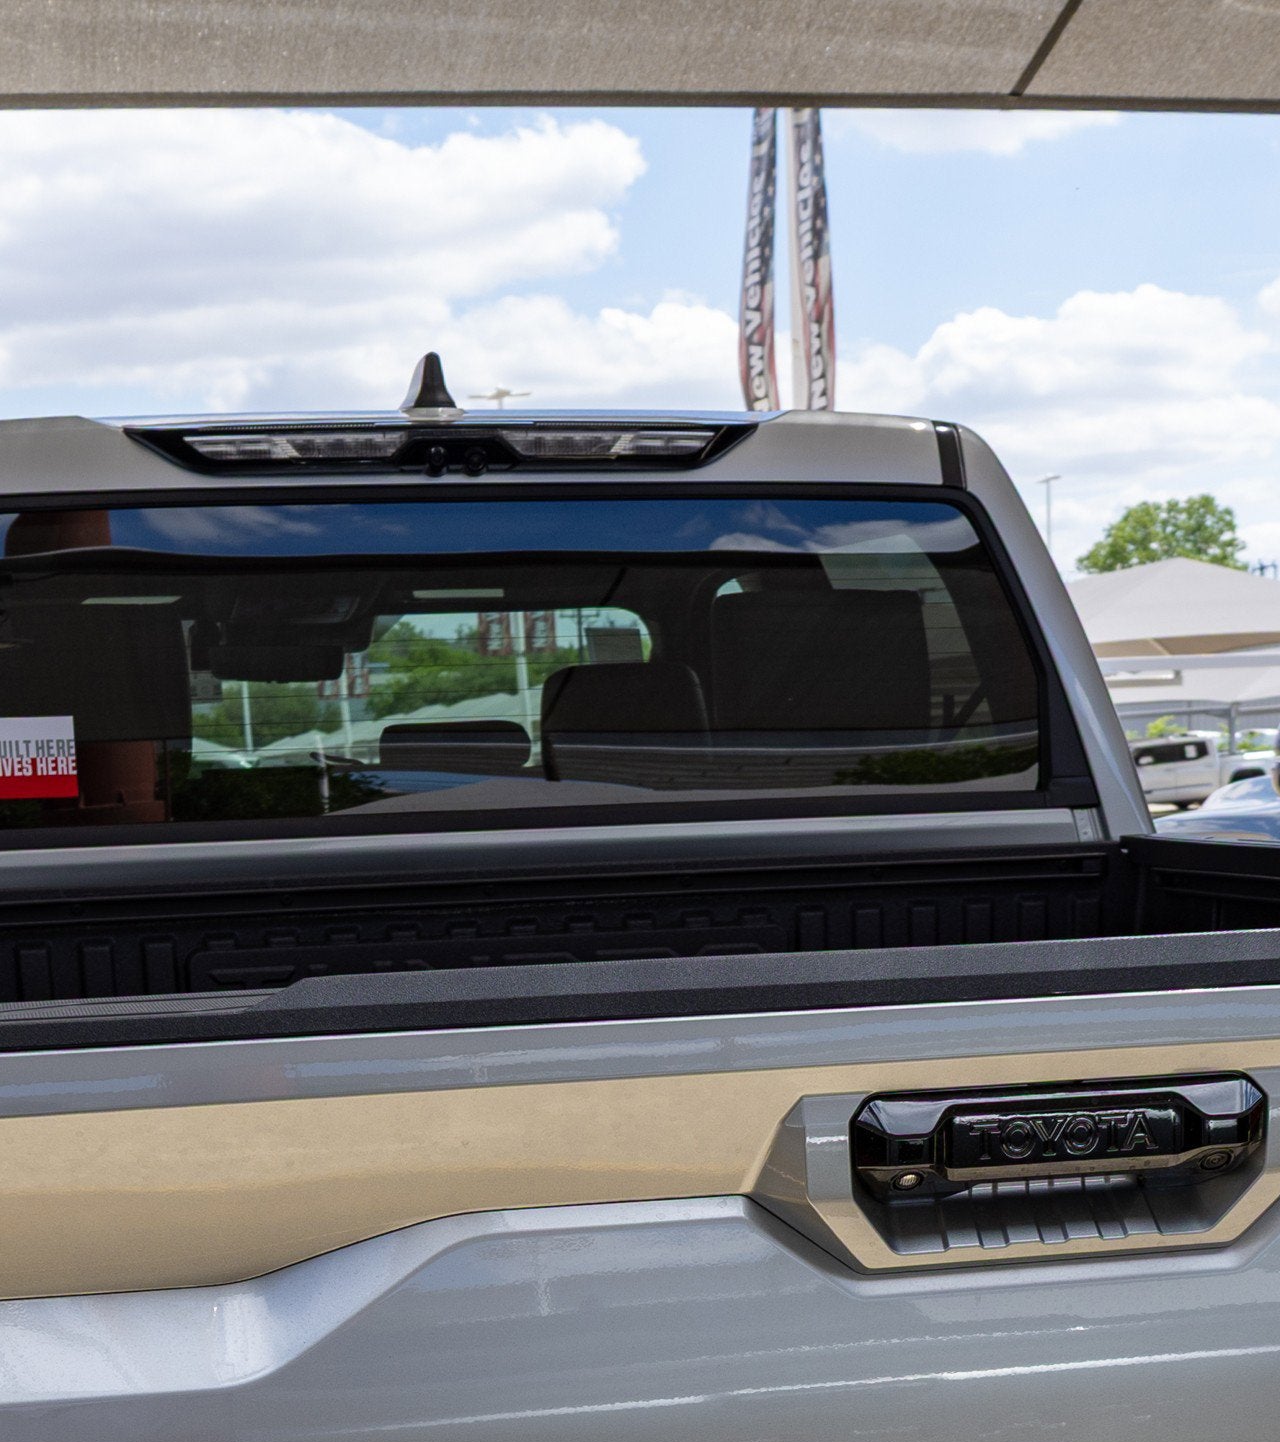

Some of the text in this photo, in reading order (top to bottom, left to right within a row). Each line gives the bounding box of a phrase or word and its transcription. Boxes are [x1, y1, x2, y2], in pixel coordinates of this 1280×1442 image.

[809, 322, 827, 411] New
[36, 739, 75, 757] HERE
[36, 757, 77, 776] HERE
[969, 1112, 1159, 1160] TOYOTA
